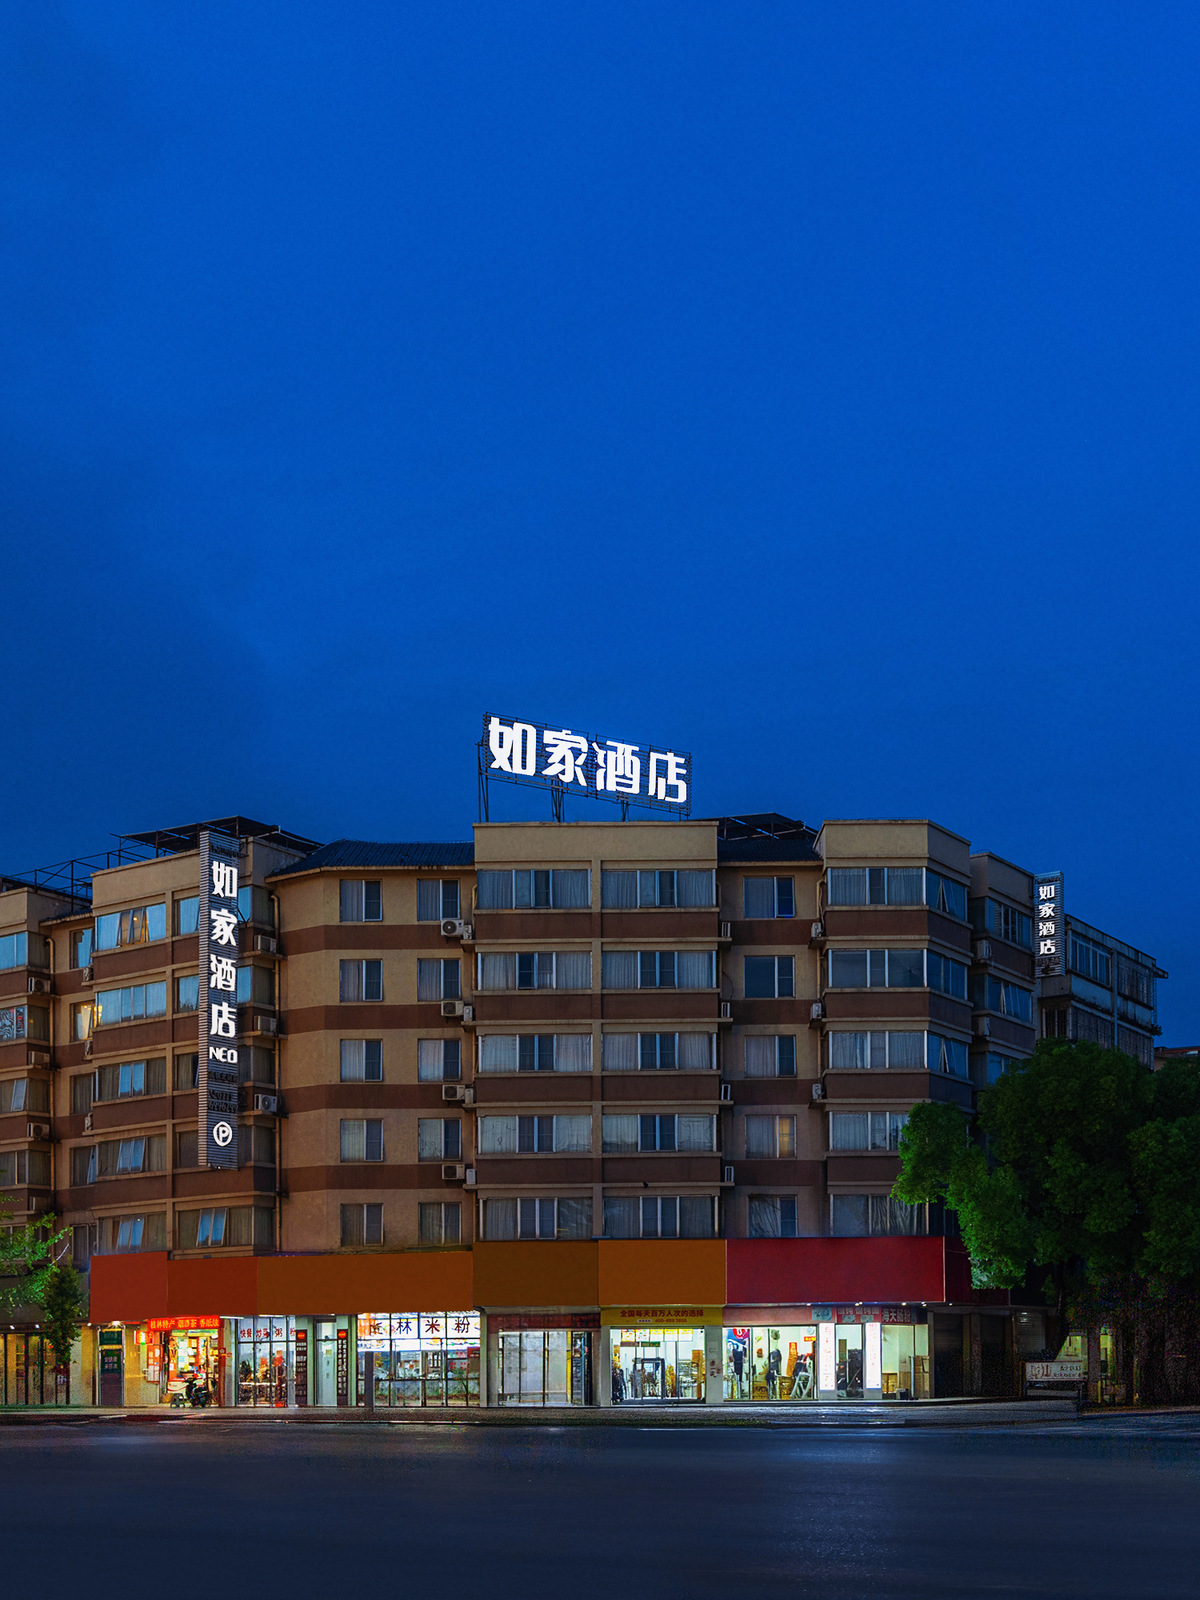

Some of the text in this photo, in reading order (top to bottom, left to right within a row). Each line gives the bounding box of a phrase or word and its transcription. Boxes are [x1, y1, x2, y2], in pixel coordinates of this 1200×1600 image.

[489, 717, 686, 802] 如家酒店
[210, 861, 237, 1037] 如家酒店
[1039, 885, 1055, 954] 如家酒店
[209, 1047, 237, 1063] NEO
